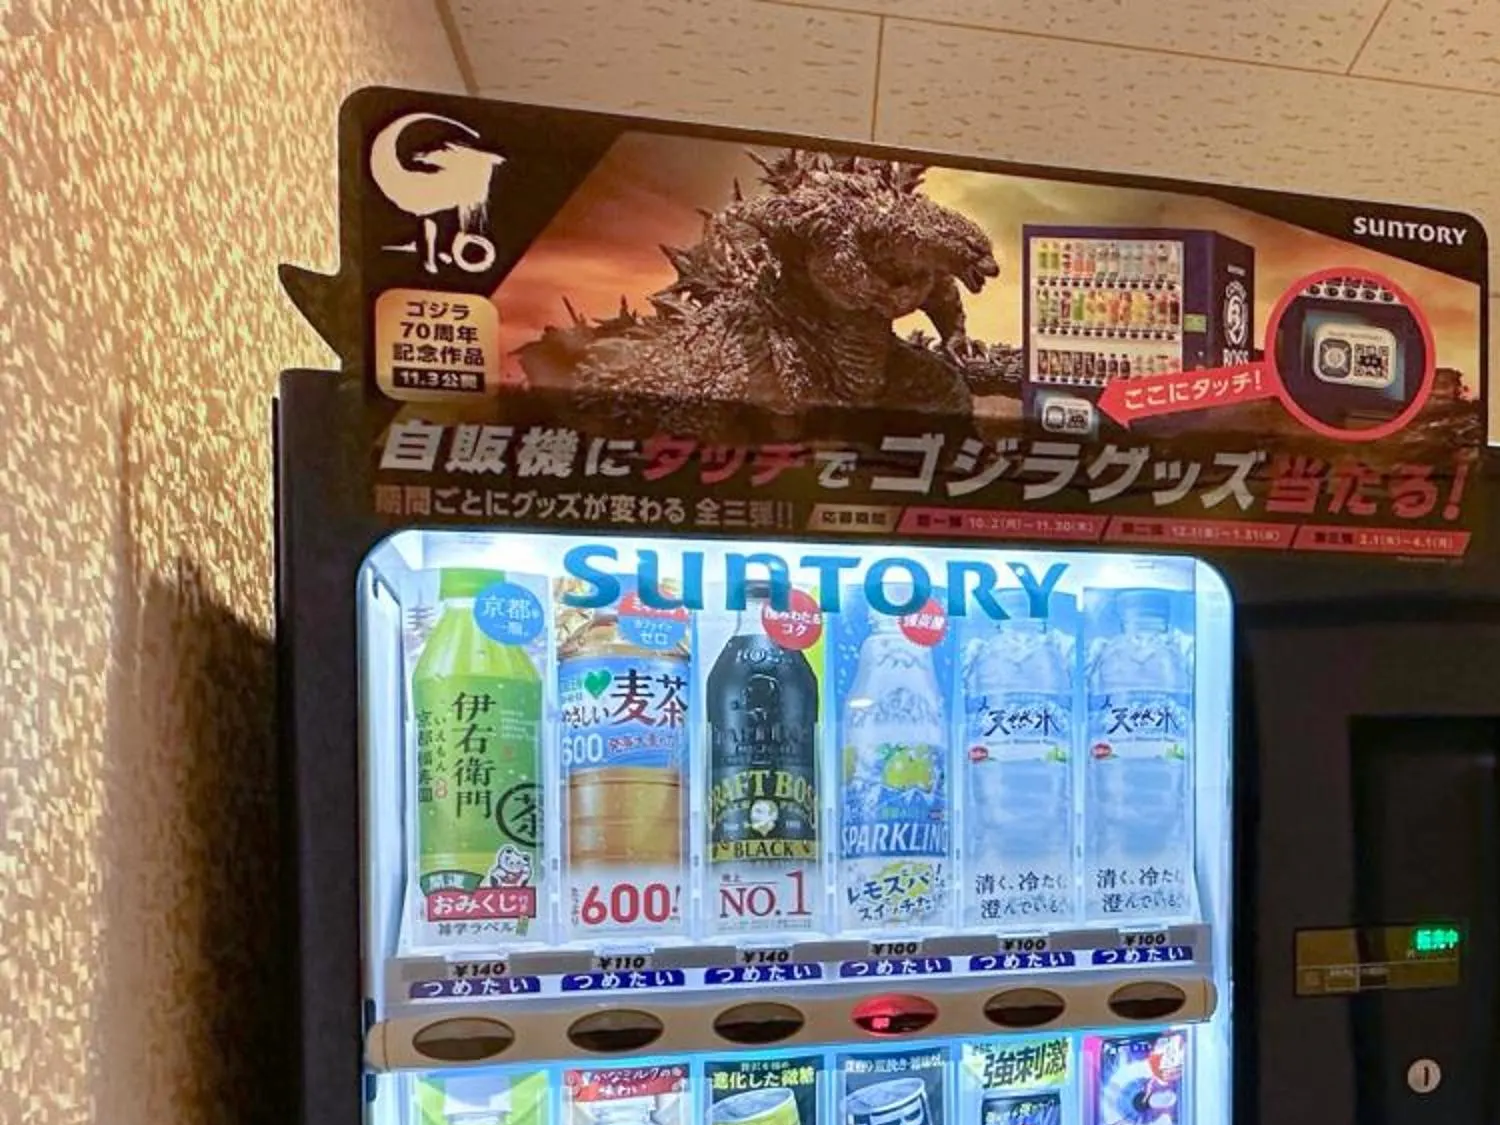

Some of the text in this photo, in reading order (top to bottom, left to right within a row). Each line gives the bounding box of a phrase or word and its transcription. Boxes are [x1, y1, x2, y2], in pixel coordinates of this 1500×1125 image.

[1354, 216, 1467, 246] SUNTORY
[406, 301, 470, 320] ゴジラ
[400, 321, 479, 345] 70周年
[394, 342, 485, 368] 記念作品
[375, 484, 686, 524] 期間ごとにグッズが変わる
[560, 544, 1070, 621] SUNTORY
[640, 632, 668, 646] ゼロ
[608, 668, 690, 730] 麦茶
[984, 706, 1061, 737] 天然水
[1107, 706, 1180, 735] 天然水
[452, 691, 498, 820] 伊右衛門
[735, 840, 794, 858] BLACK
[719, 868, 812, 919] NO.1
[872, 941, 917, 956] ¥100
[1003, 938, 1047, 952] ¥100
[1125, 932, 1165, 947] ¥100
[598, 955, 645, 971] ¥110
[742, 950, 789, 964] ¥140
[980, 953, 1067, 970] つめたい
[1101, 947, 1185, 964] つめたい
[453, 961, 506, 979] ¥140
[719, 965, 812, 983] つめたい
[851, 959, 942, 976] つめたい
[423, 978, 529, 996] つめたい
[573, 971, 675, 989] つめたい
[982, 1037, 1067, 1089] 強刺激
